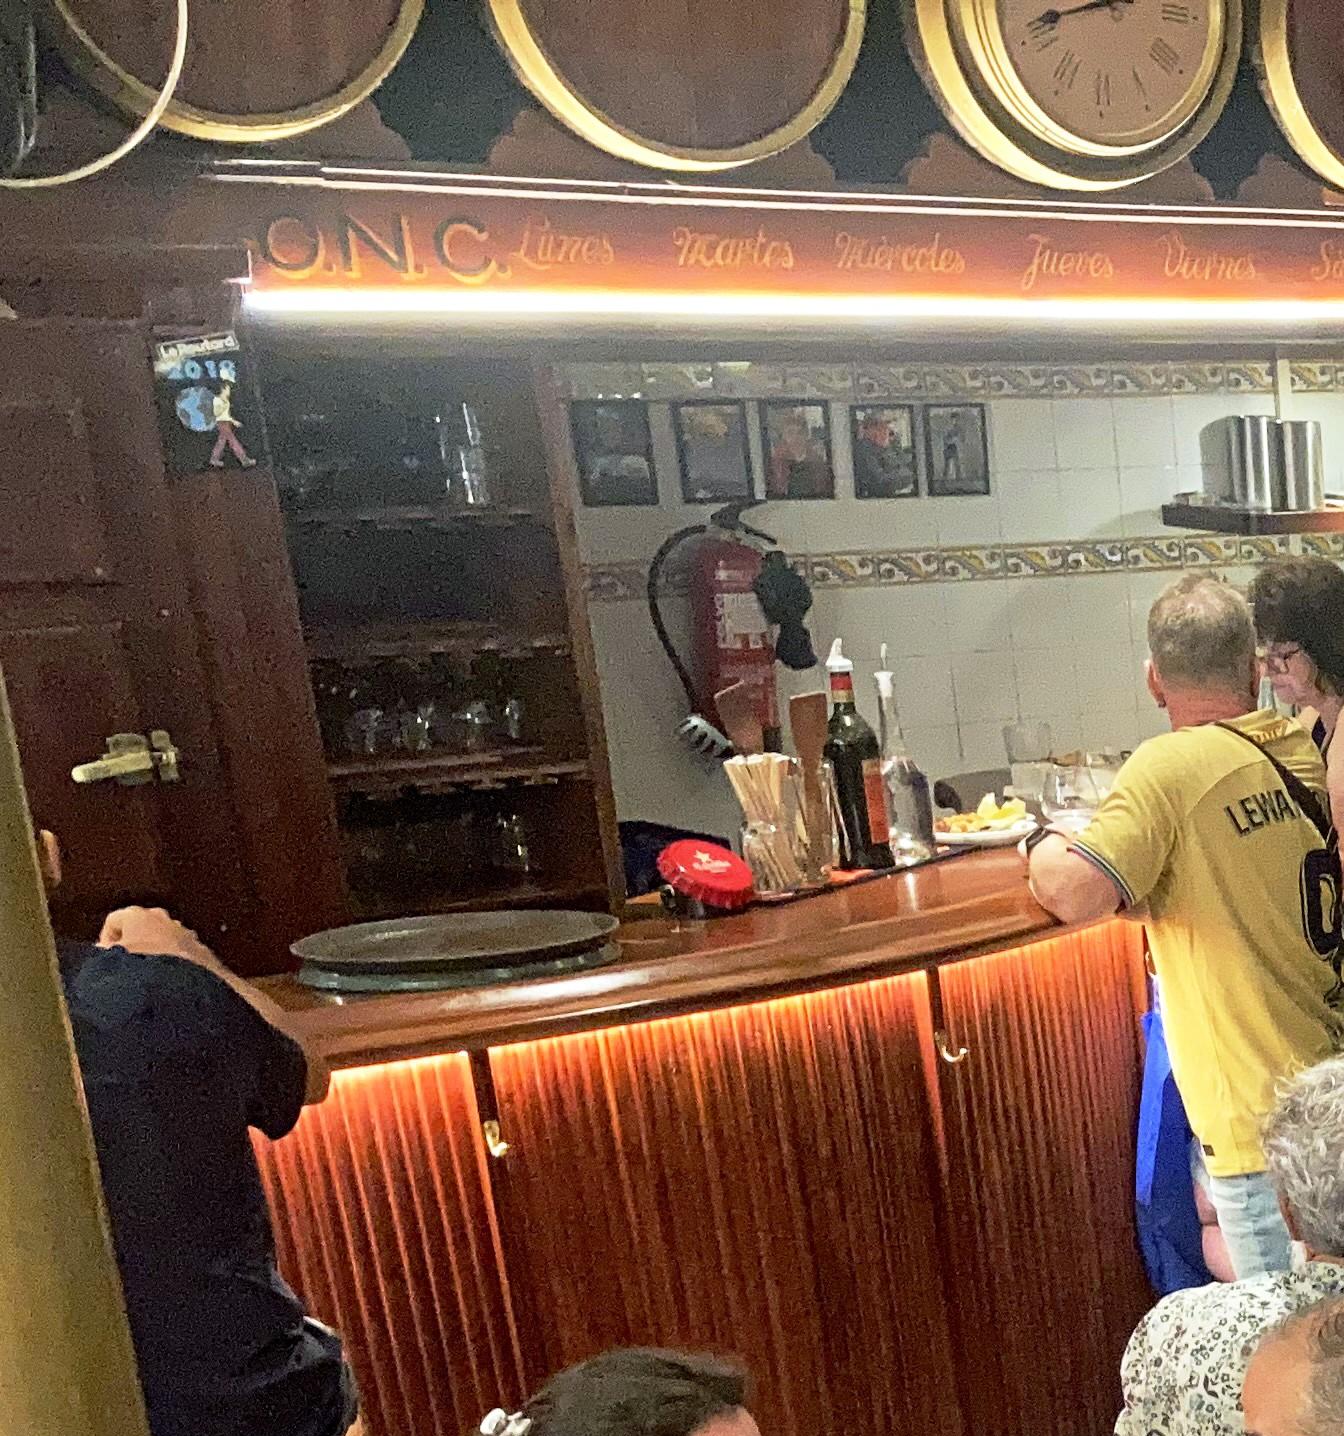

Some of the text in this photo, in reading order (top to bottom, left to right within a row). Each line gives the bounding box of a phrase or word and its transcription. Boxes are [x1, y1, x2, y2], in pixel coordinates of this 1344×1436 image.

[673, 225, 794, 268] Martes
[1022, 233, 1115, 290] Jueves
[1157, 228, 1258, 281] Viernes
[1224, 788, 1301, 838] LEWA
